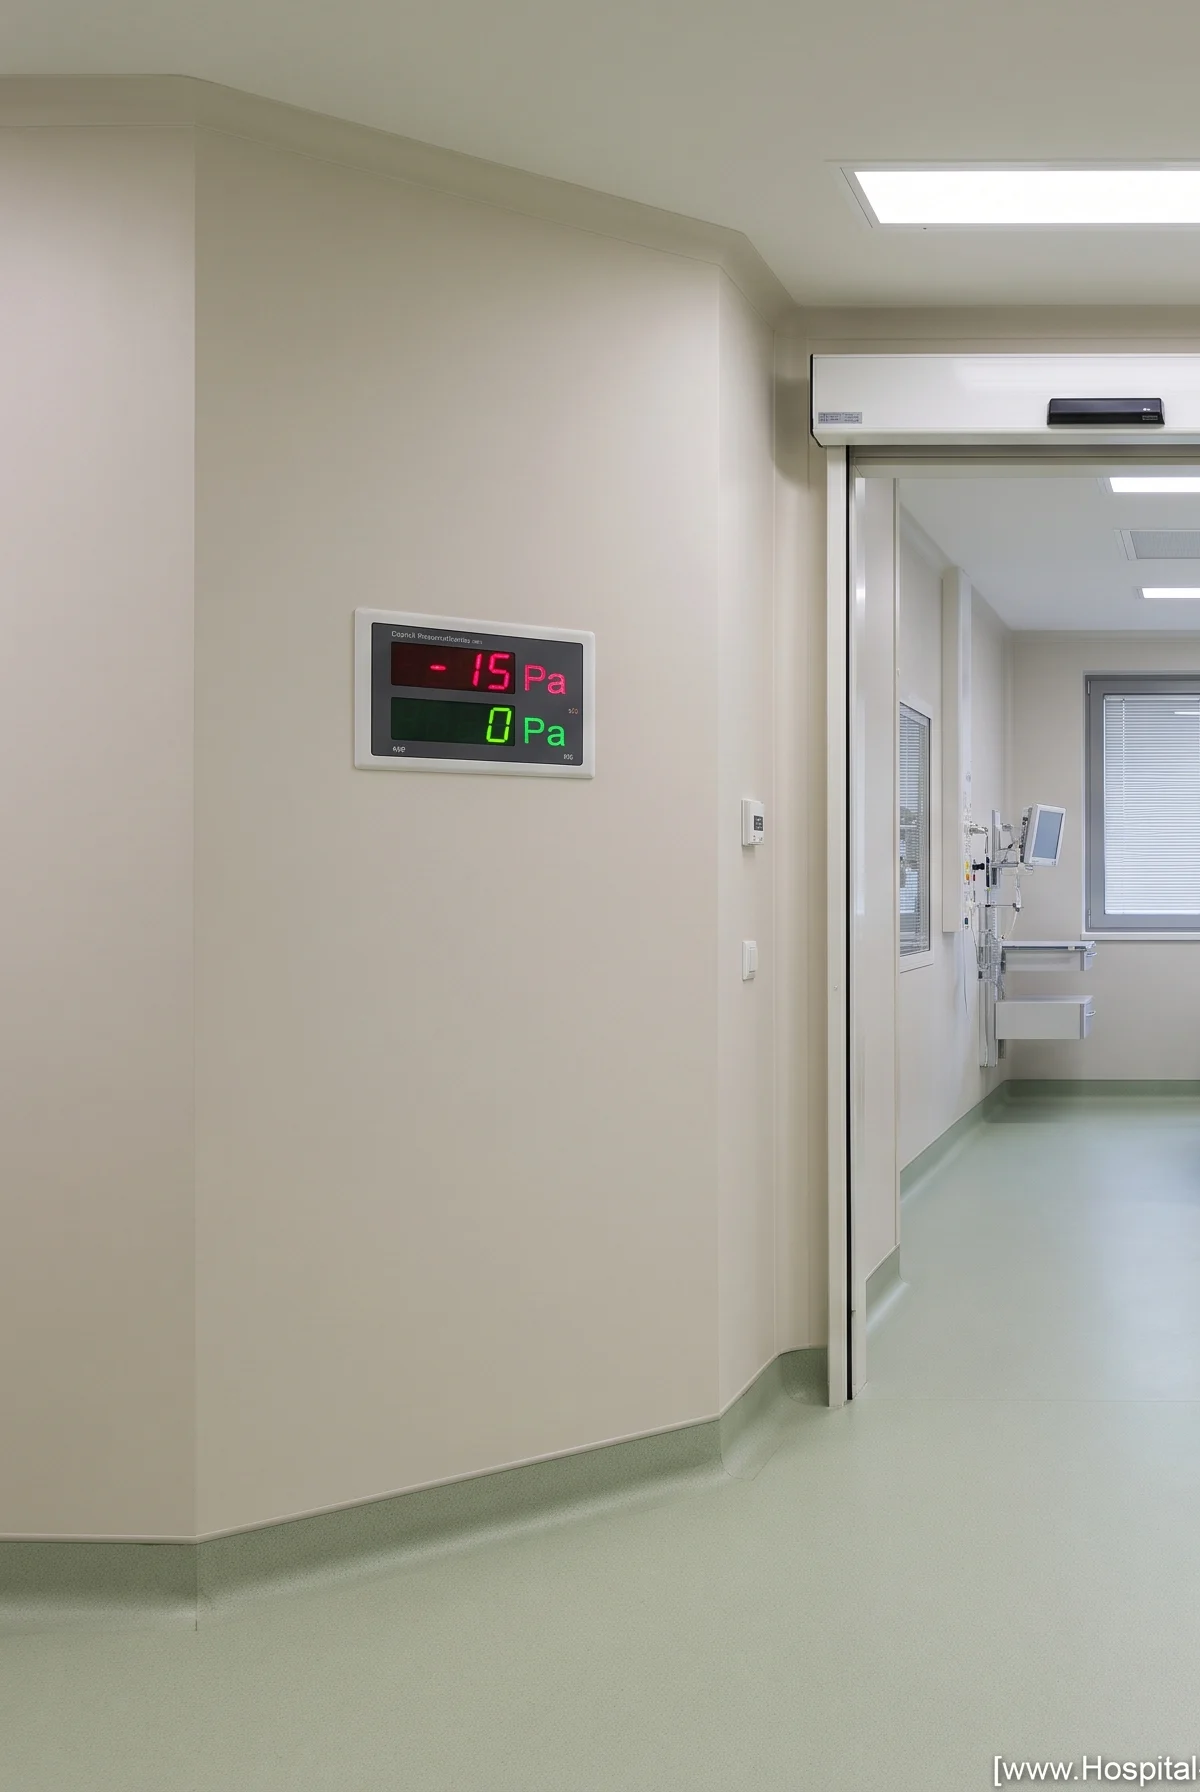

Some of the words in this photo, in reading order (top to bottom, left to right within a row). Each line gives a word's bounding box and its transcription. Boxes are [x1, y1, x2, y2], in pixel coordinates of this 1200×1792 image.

[524, 665, 567, 694] Pa
[486, 707, 512, 744] 0
[524, 717, 566, 747] Pa
